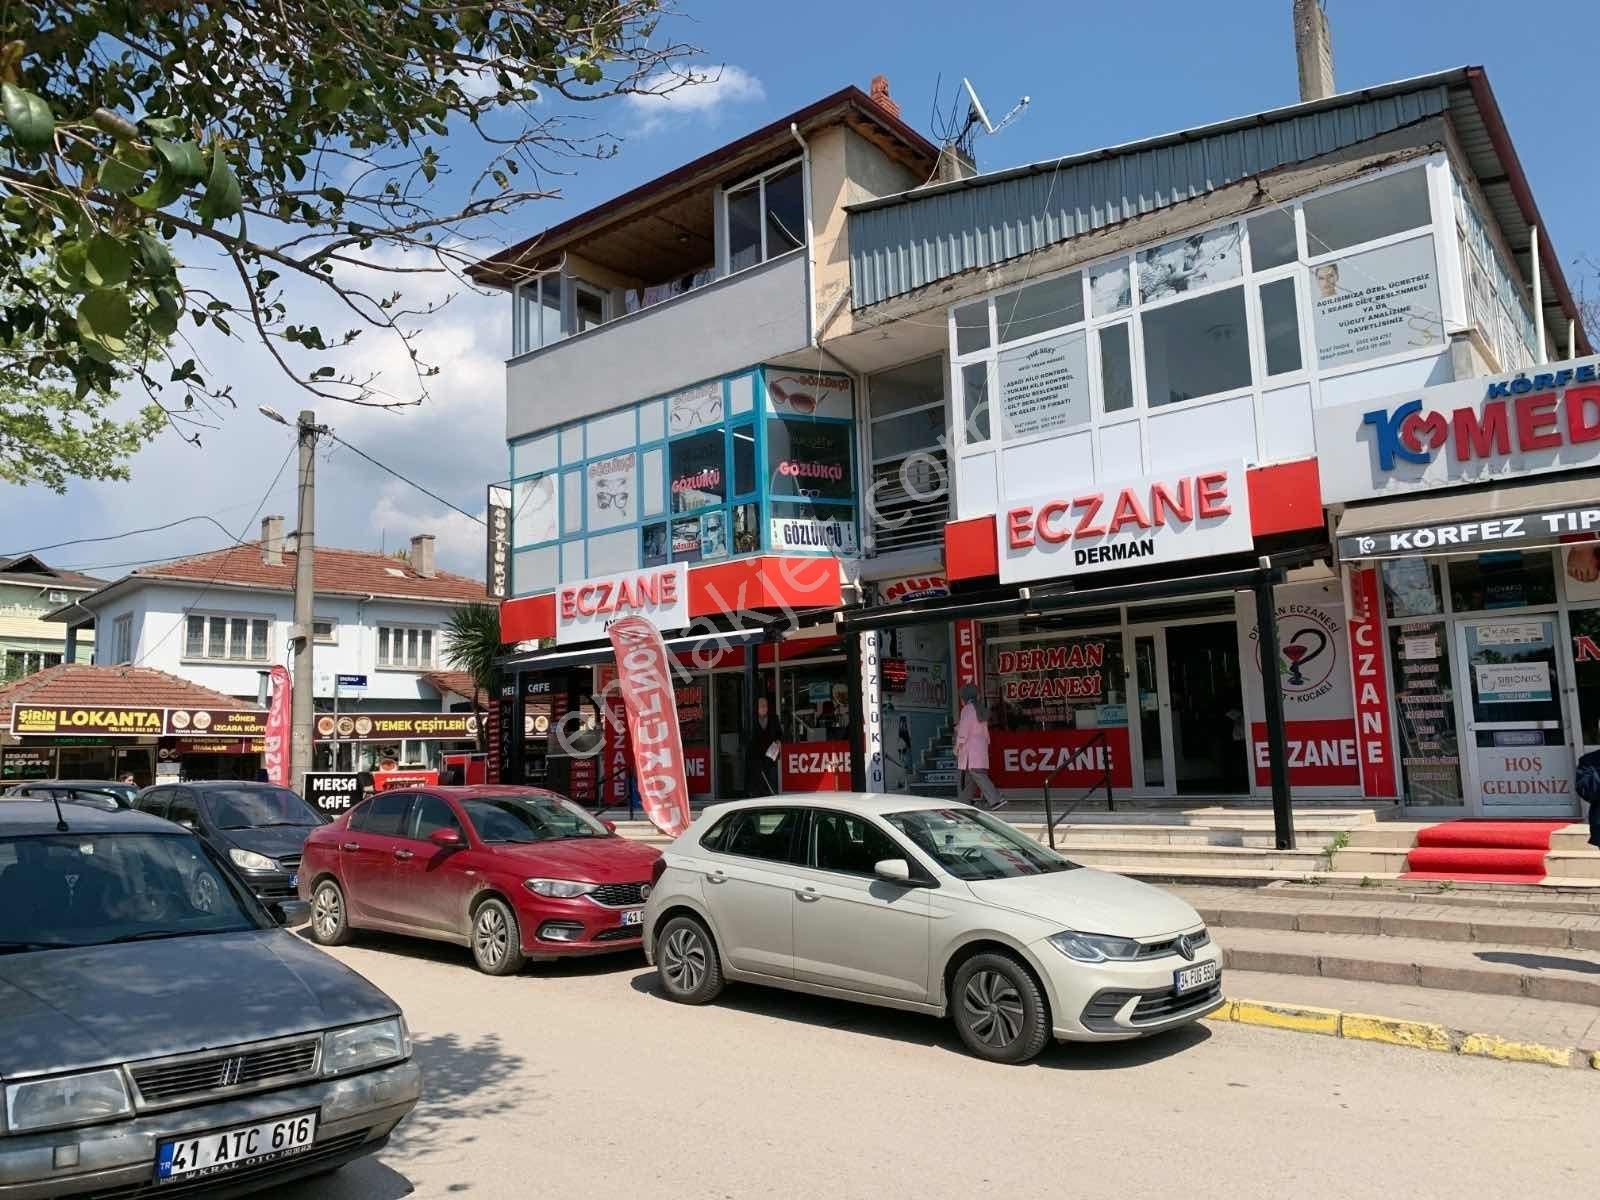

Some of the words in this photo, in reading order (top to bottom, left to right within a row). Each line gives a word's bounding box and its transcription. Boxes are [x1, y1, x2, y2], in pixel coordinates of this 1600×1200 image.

[1488, 364, 1600, 399] KÖRFE
[671, 469, 720, 493] GÖZLÜKÇÜ
[779, 459, 843, 484] GÖZLÜKÇÜ
[1007, 471, 1232, 550] ECZANE
[784, 521, 843, 547] GÖZLÜKÇÜ
[1390, 518, 1526, 550] KÖRFEZ
[1542, 510, 1600, 533] TIP
[1075, 539, 1155, 567] DERMAN
[560, 571, 678, 619] ECZANE
[1249, 608, 1286, 640] DEAN
[1290, 605, 1342, 633] ECZANESİ
[999, 643, 1105, 675] DERMAN
[528, 682, 551, 693] CAFE
[1006, 672, 1103, 700] ECZANESİ
[1296, 680, 1334, 703] KOCAELİ
[18, 709, 57, 723] ŞİRİN
[60, 710, 161, 726] LOKANTA
[228, 714, 256, 722] DÖNER
[867, 637, 882, 782] GÖZLÜKÇÜ
[214, 724, 242, 732] IZGARA
[244, 724, 267, 732] KÖFT
[375, 720, 412, 731] YEMEK
[414, 717, 465, 733] ÇEŞİTLERİ
[613, 704, 626, 796] ECZANE
[1004, 746, 1114, 772] ECZANE
[1255, 739, 1356, 768] EZANE
[788, 752, 851, 774] ECZANE
[1503, 756, 1544, 773] HOŞ
[313, 778, 356, 791] MERSA
[1483, 774, 1570, 796] GELDİNİZ
[318, 796, 351, 809] CAFE
[160, 1161, 171, 1169] TR
[173, 1140, 199, 1169] 41
[215, 1129, 260, 1162] ATC
[272, 1118, 310, 1149] 616
[200, 1163, 239, 1176] KRAL
